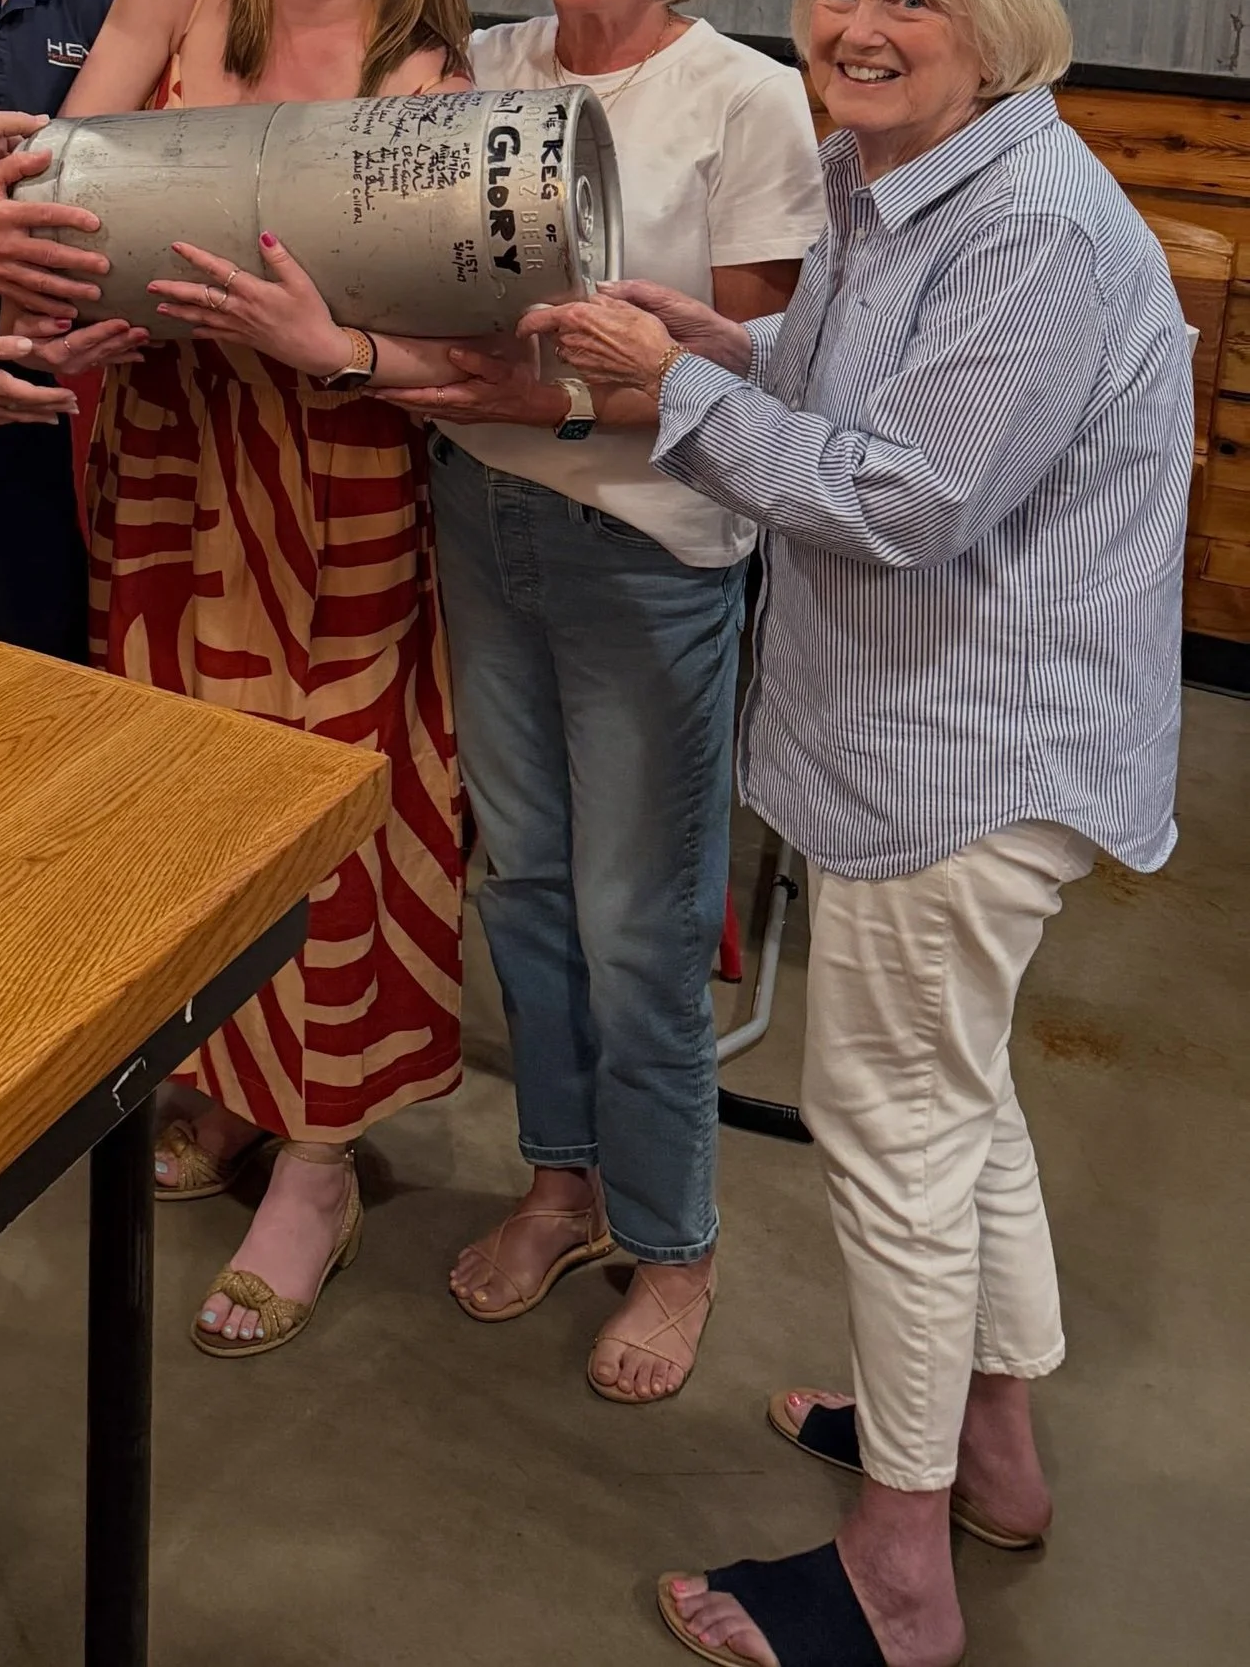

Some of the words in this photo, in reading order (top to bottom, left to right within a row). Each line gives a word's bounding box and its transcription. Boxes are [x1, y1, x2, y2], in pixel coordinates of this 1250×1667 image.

[487, 126, 521, 274] GLORY
[540, 139, 564, 200] KEG
[521, 210, 545, 271] BEER
[546, 223, 557, 243] OF
